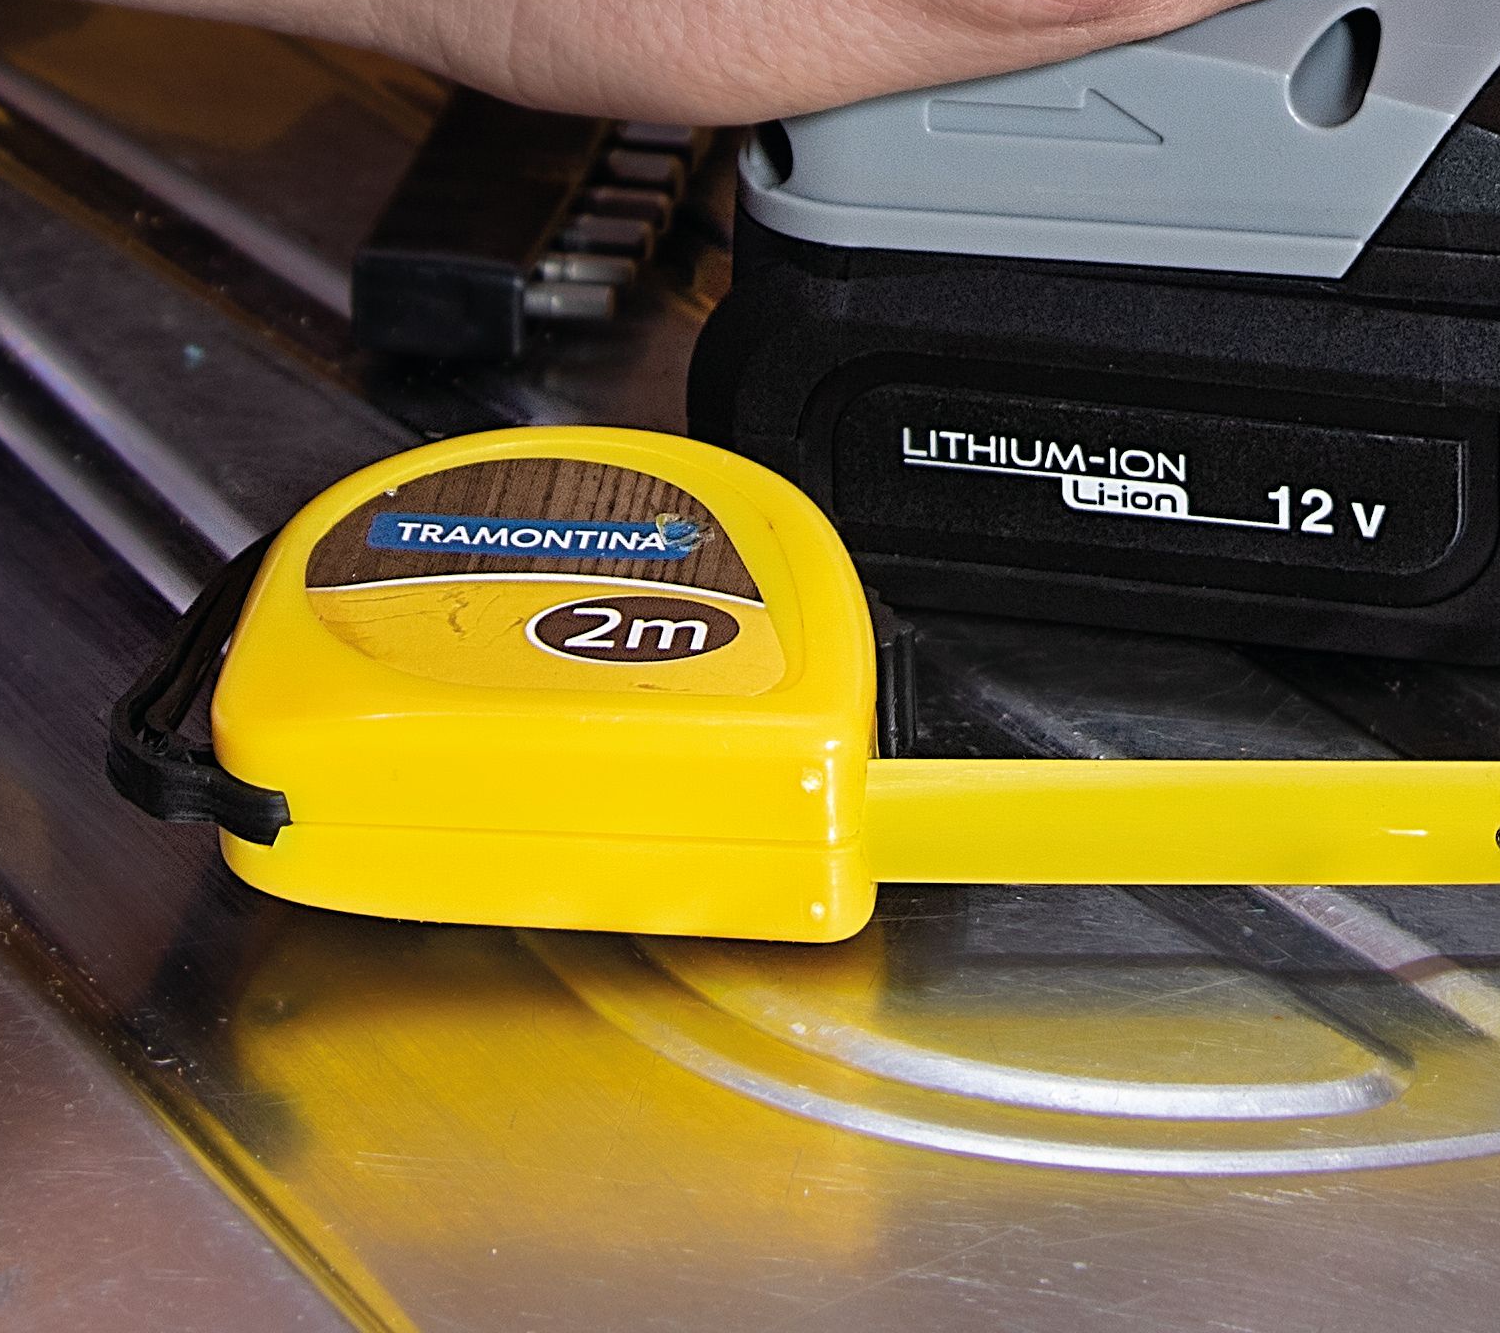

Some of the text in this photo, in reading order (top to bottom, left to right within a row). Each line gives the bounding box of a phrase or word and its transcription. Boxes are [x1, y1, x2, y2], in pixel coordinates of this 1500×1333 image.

[902, 426, 1186, 482] LITHIUM-ION
[1072, 480, 1178, 514] Li-ion
[1267, 485, 1335, 534] 12
[397, 521, 667, 552] TRAMONTINA
[564, 606, 708, 651] 2m
